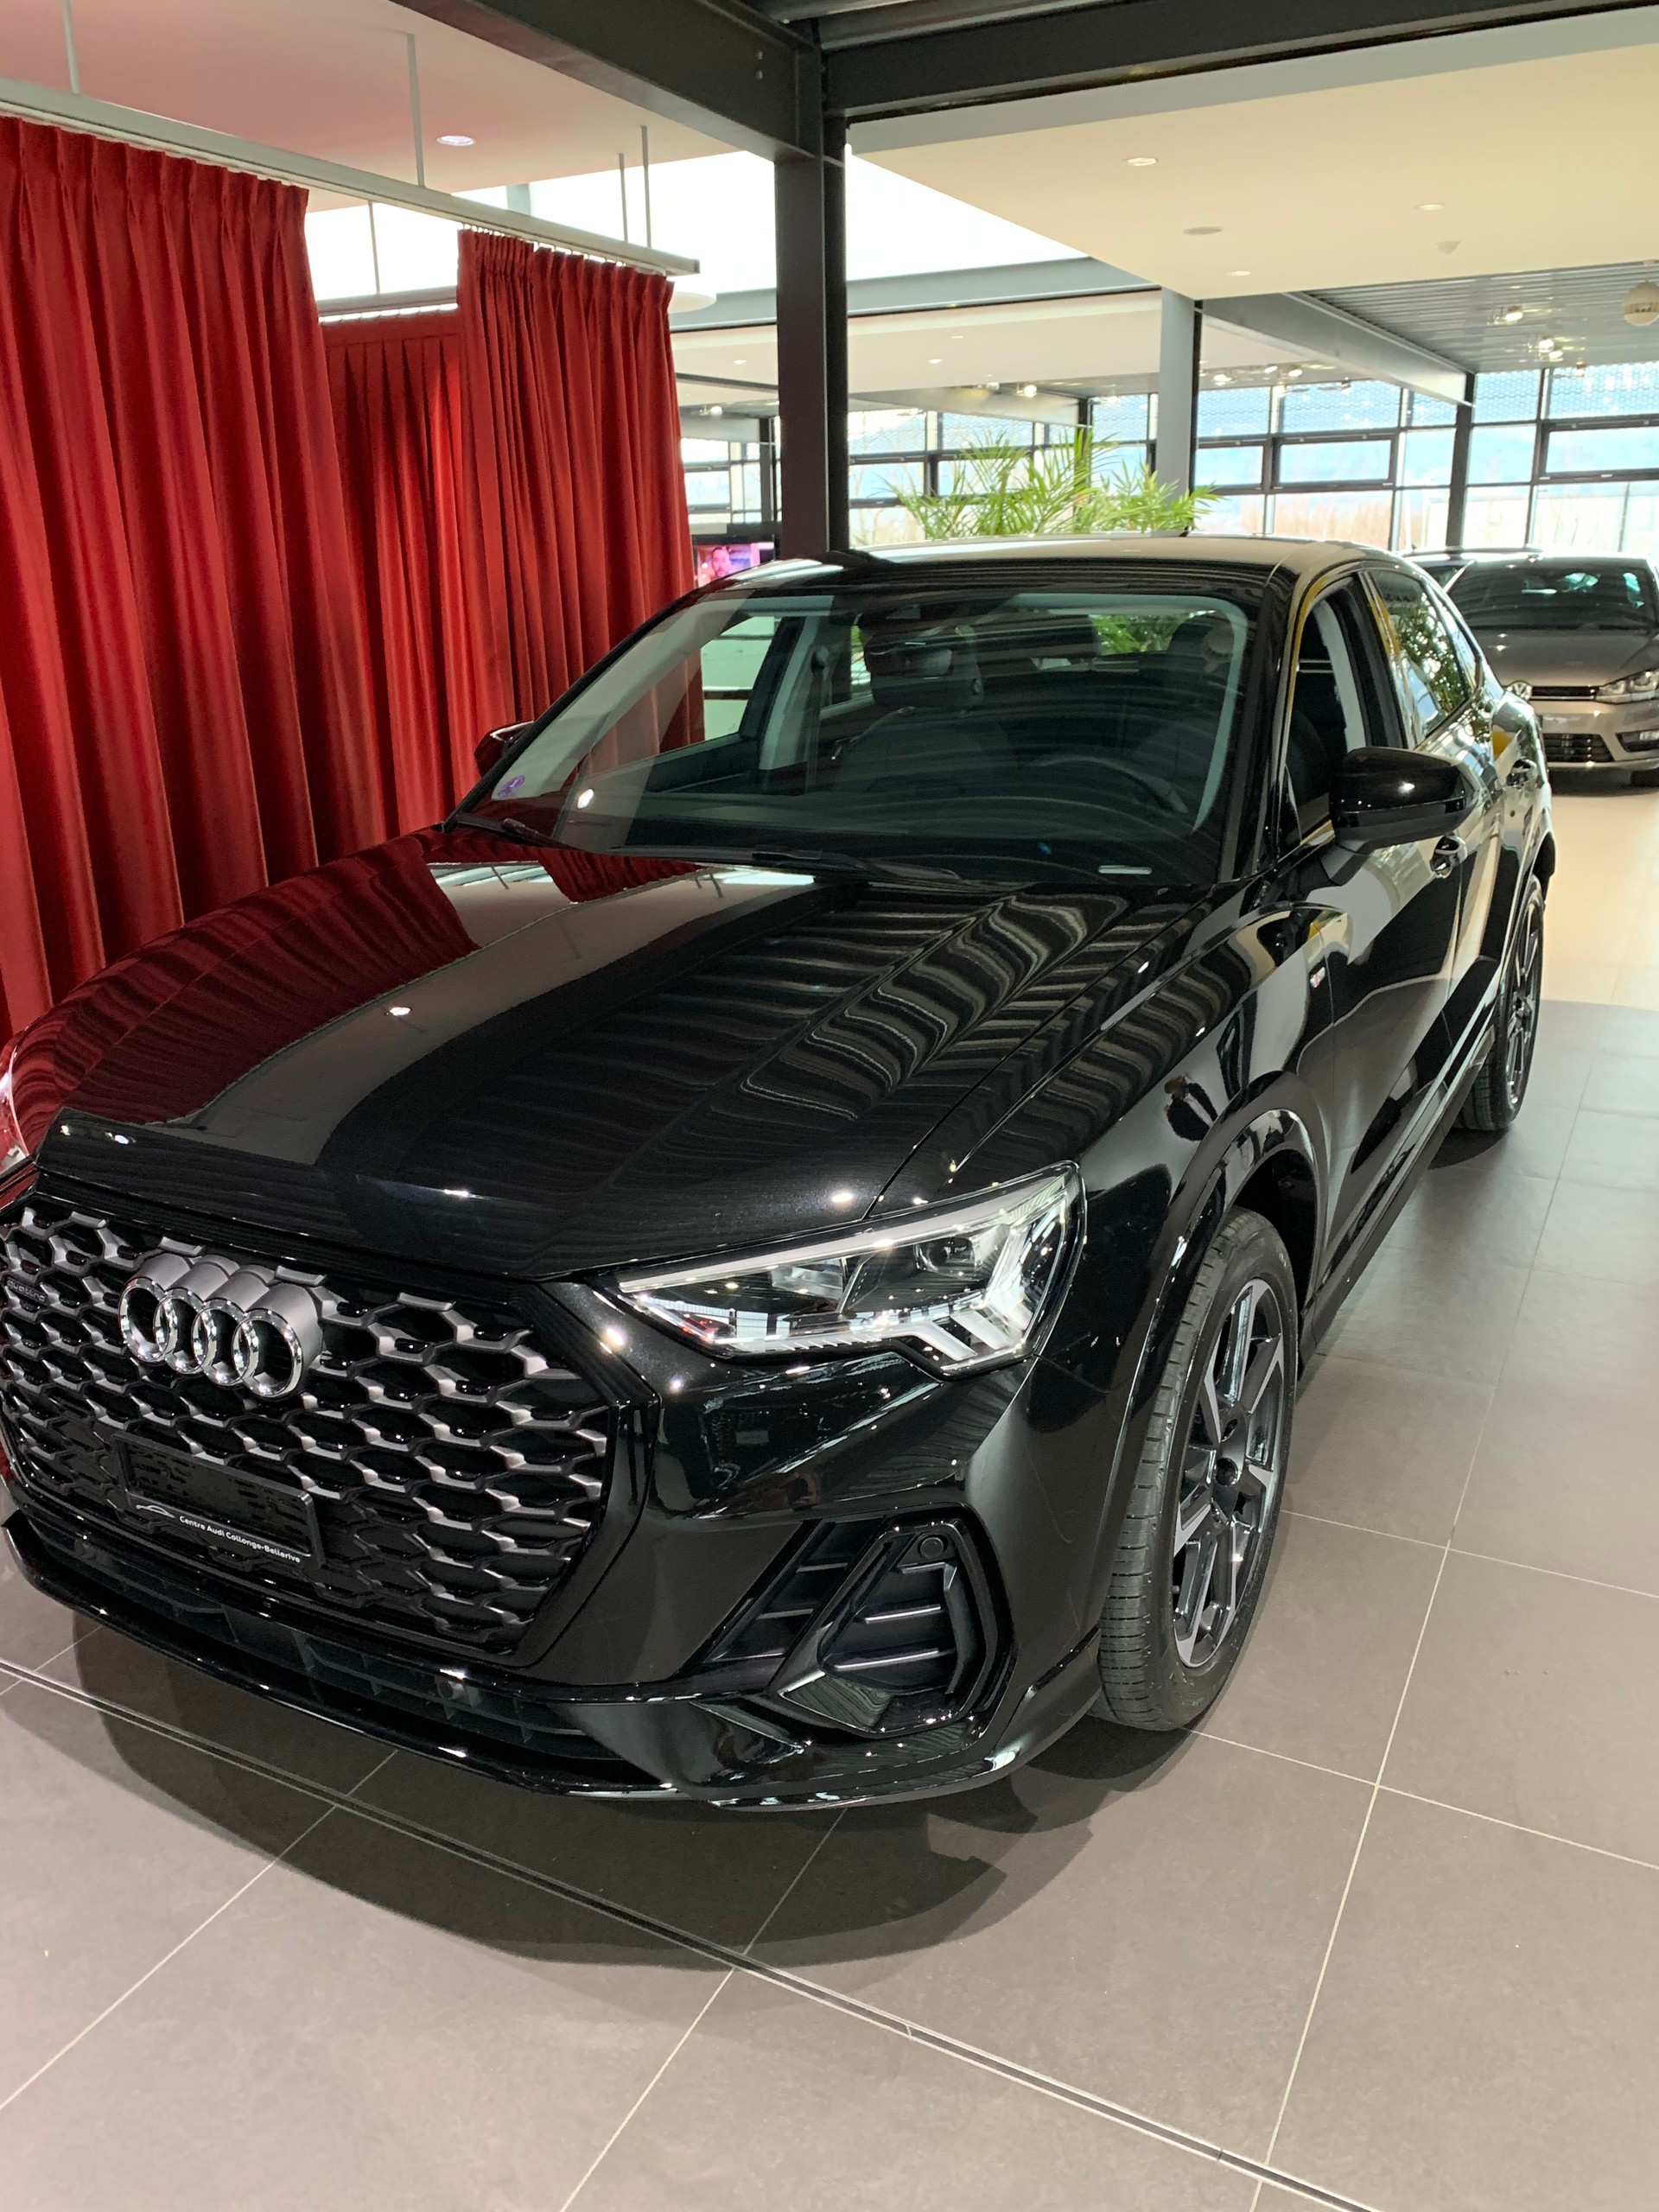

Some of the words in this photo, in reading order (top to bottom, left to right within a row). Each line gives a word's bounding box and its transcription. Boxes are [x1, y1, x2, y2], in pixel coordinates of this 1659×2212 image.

[7, 1279, 46, 1302] quattro
[179, 1515, 206, 1530] Centre
[207, 1524, 225, 1537] Audi
[226, 1531, 301, 1563] Collonge-Bellerive
